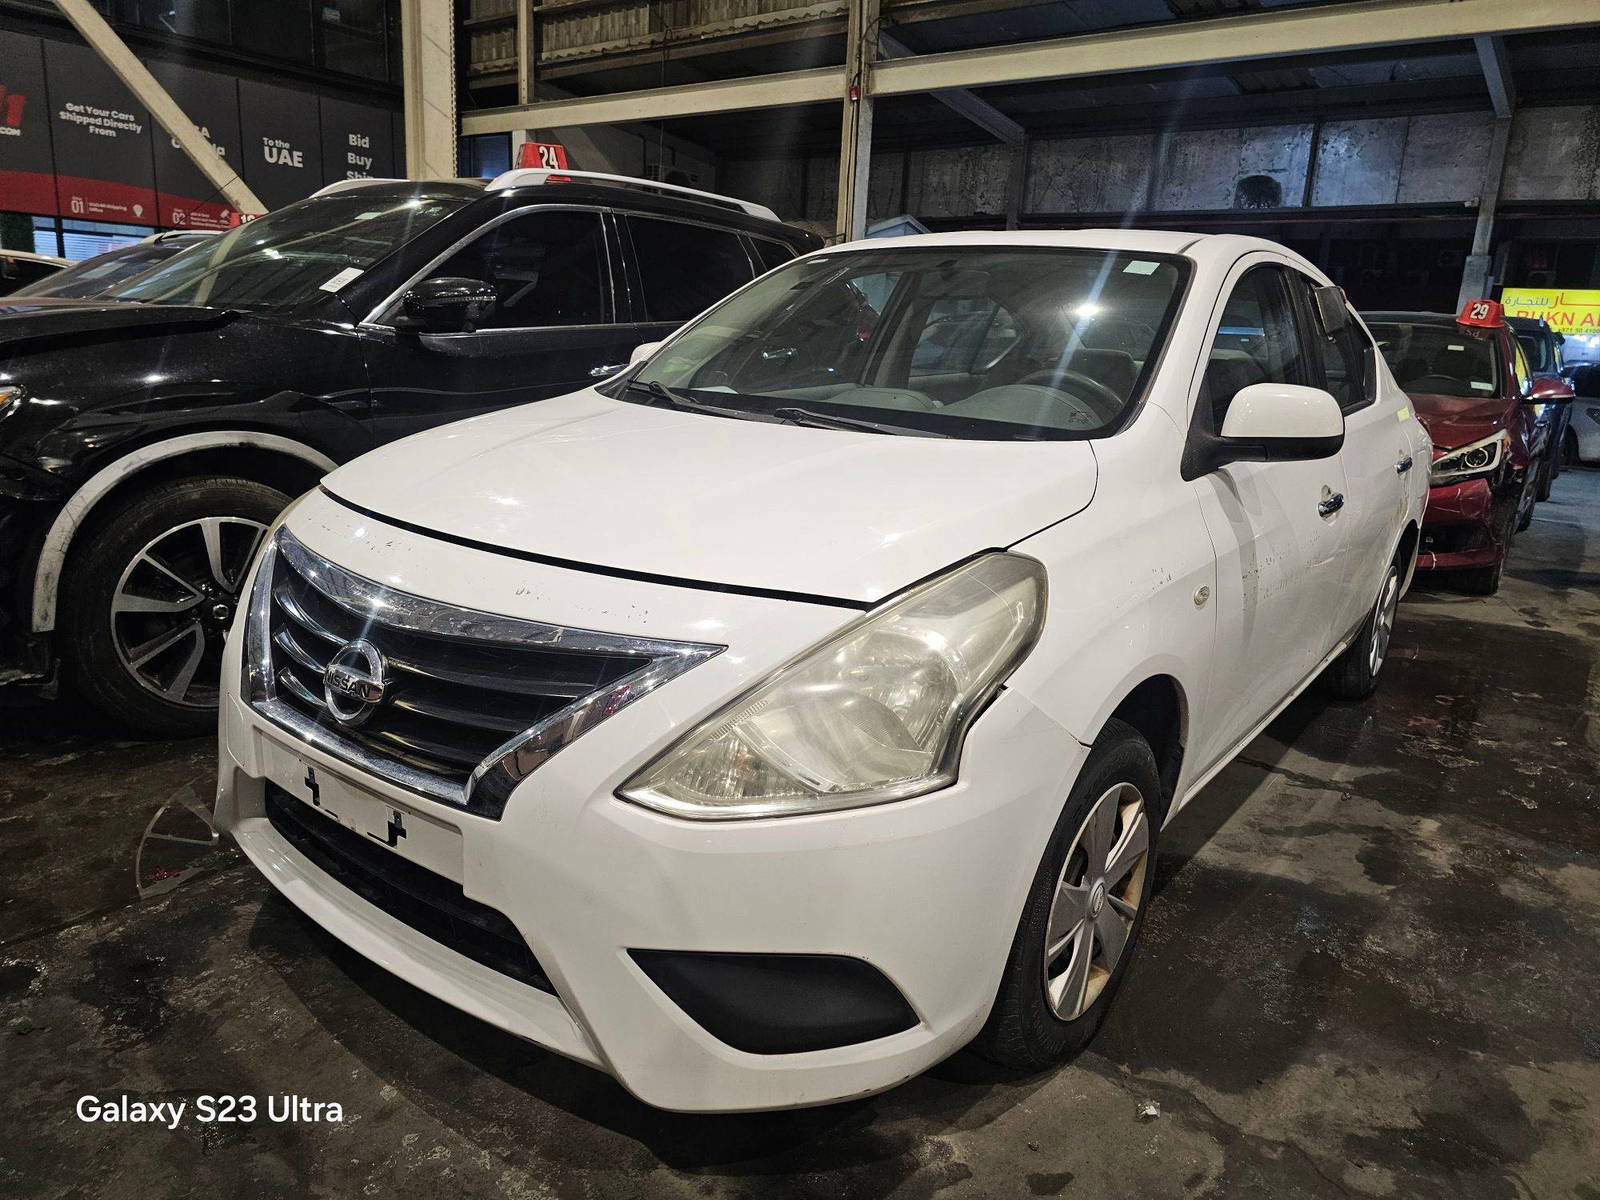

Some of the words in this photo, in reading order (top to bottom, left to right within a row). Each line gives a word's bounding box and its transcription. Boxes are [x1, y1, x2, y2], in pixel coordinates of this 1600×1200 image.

[66, 102, 85, 113] Get
[86, 105, 110, 117] Your
[111, 110, 135, 122] Cars
[59, 111, 102, 125] Shipped
[103, 118, 142, 134] Directly
[89, 125, 117, 137] From
[262, 137, 275, 147] To
[275, 139, 291, 150] the
[348, 134, 369, 149] Bid
[263, 146, 304, 169] UAE
[347, 152, 373, 170] Buy
[539, 145, 559, 170] 24
[1469, 303, 1489, 320] 29
[326, 665, 372, 699] NISSAN
